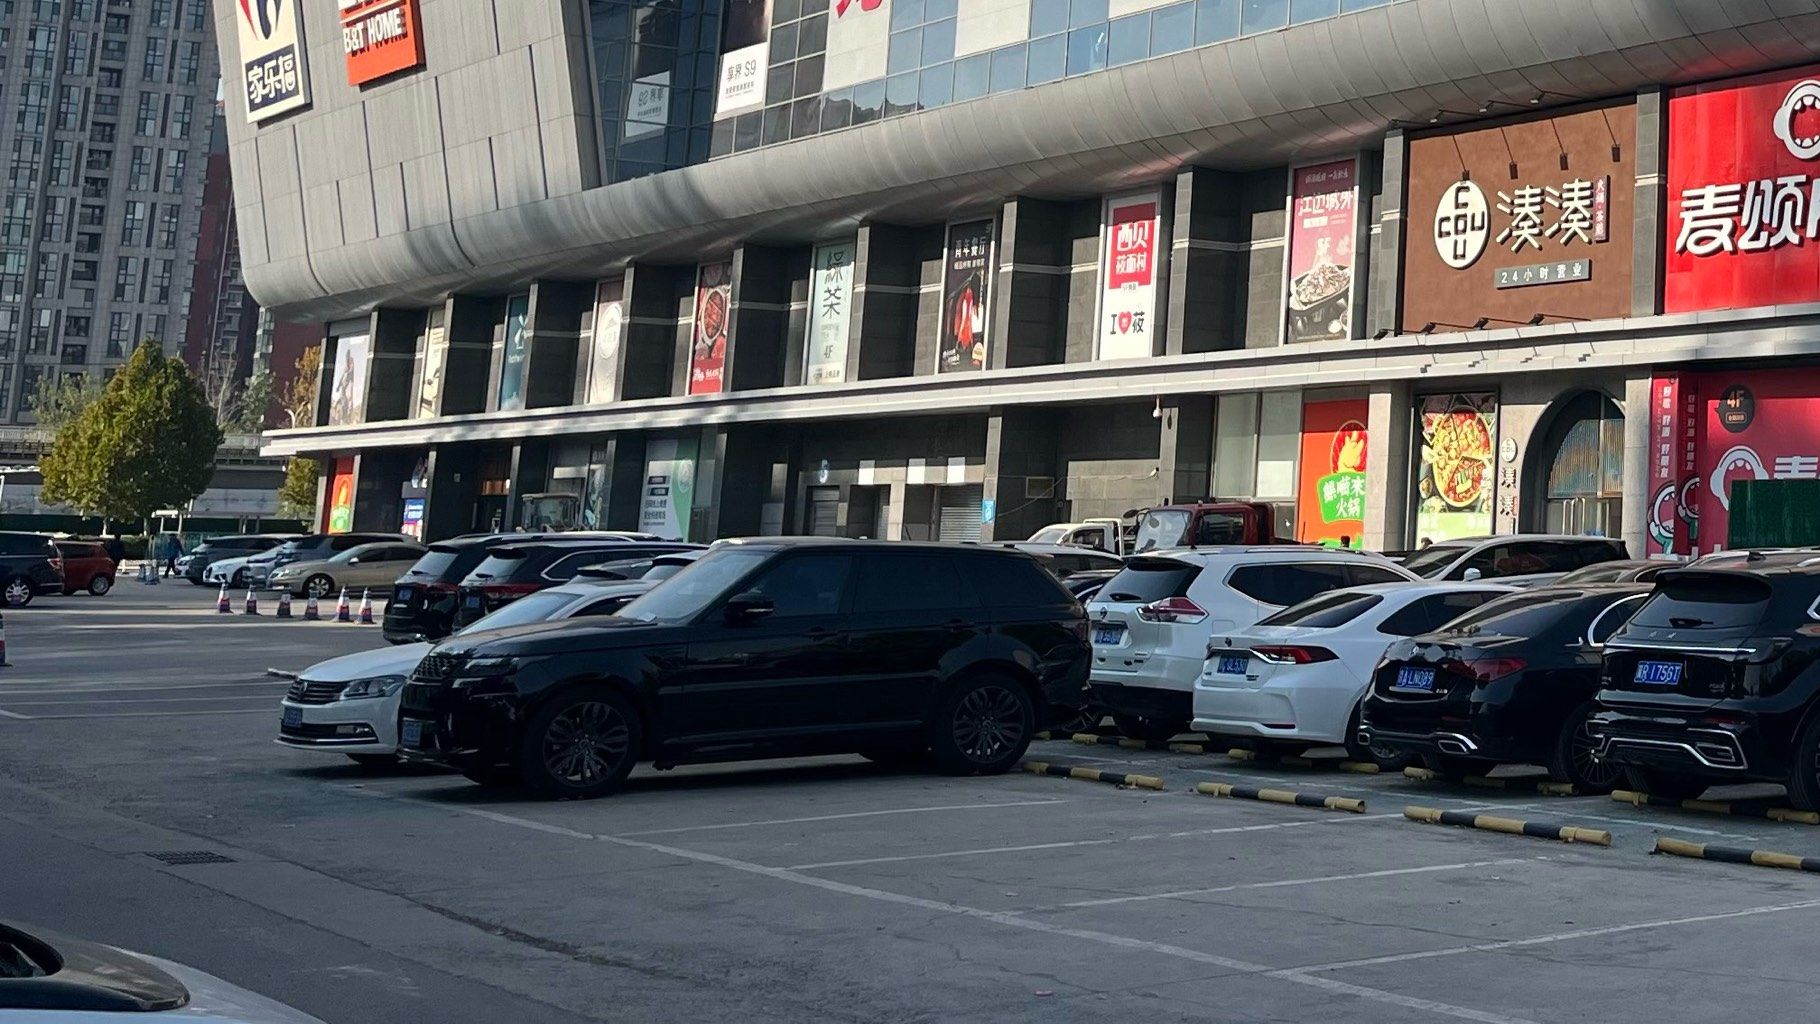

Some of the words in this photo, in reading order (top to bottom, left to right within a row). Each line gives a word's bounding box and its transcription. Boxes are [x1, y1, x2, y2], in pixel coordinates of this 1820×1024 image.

[342, 24, 365, 54] B&T
[367, 8, 403, 44] HOME
[249, 54, 296, 104] 家乐福
[1117, 221, 1149, 251] 西贝
[1501, 263, 1582, 283] 24小时营业
